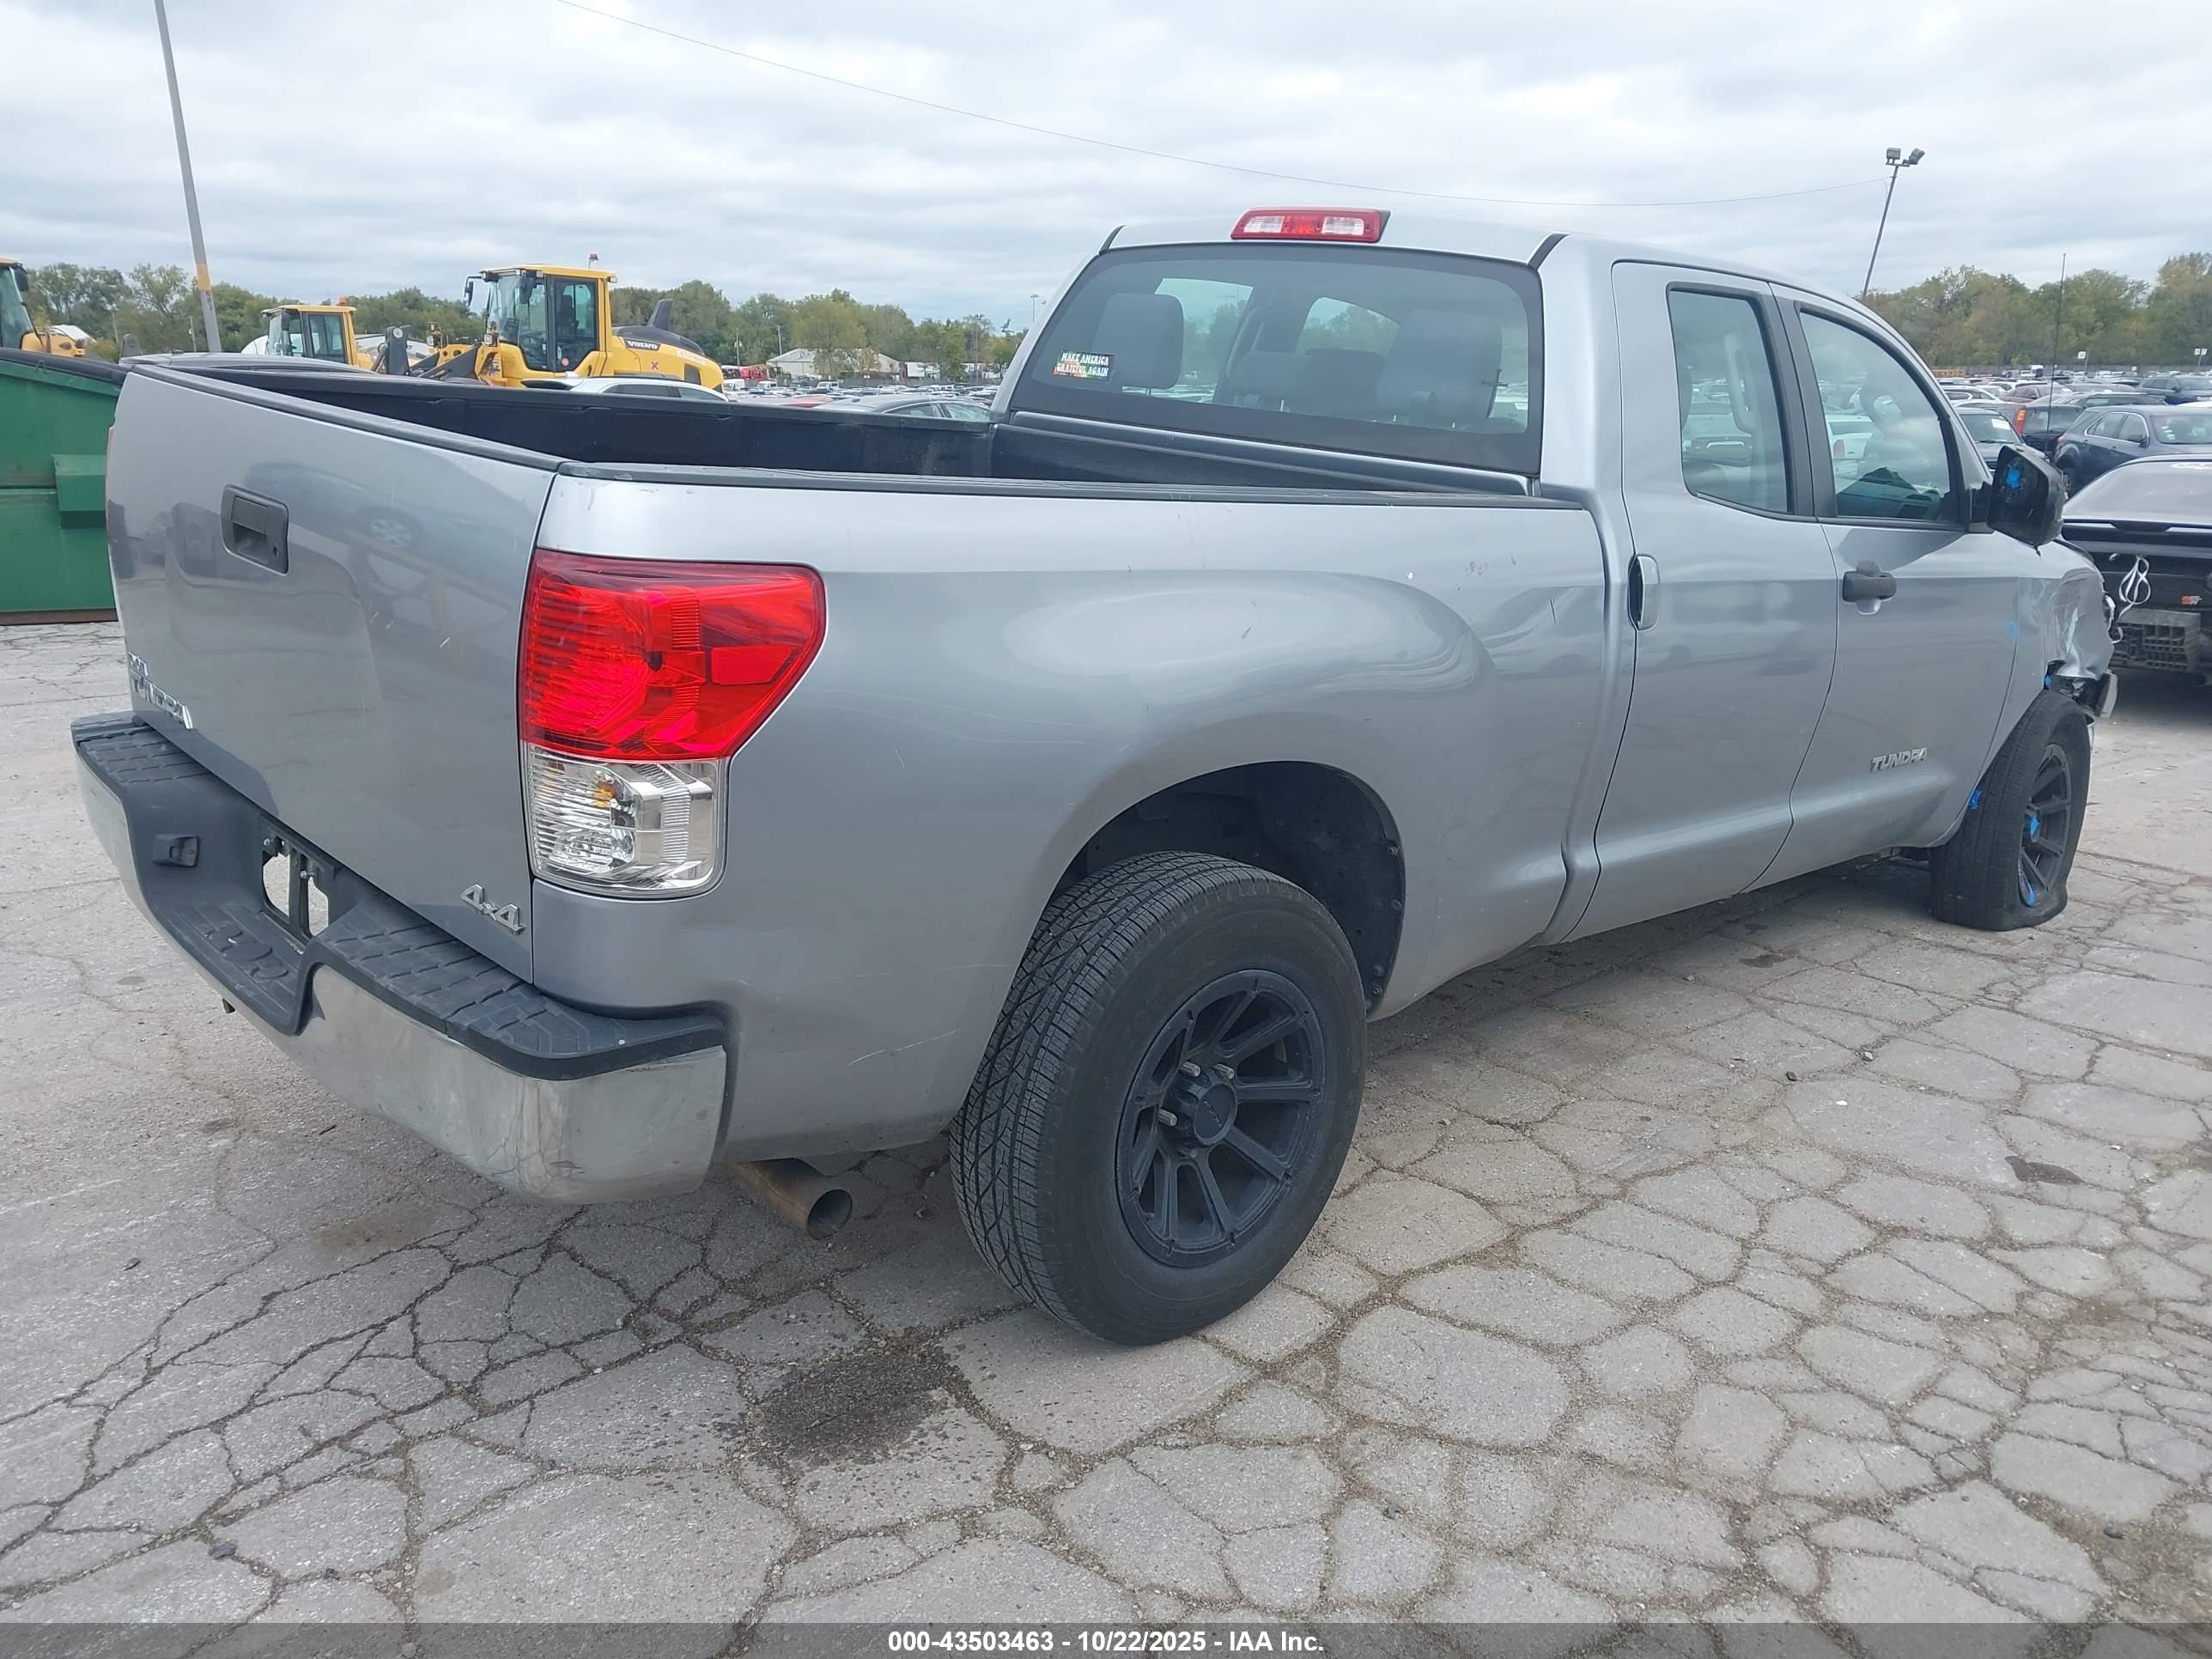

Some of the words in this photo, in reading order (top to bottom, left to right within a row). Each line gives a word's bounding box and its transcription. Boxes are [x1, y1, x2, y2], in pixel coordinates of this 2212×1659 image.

[627, 340, 658, 349] VOLVO
[1060, 352, 1080, 362] MAKE
[1080, 354, 1109, 366] AMERICA
[1087, 366, 1109, 377] AGAIN
[1870, 746, 1928, 772] TUNDRA
